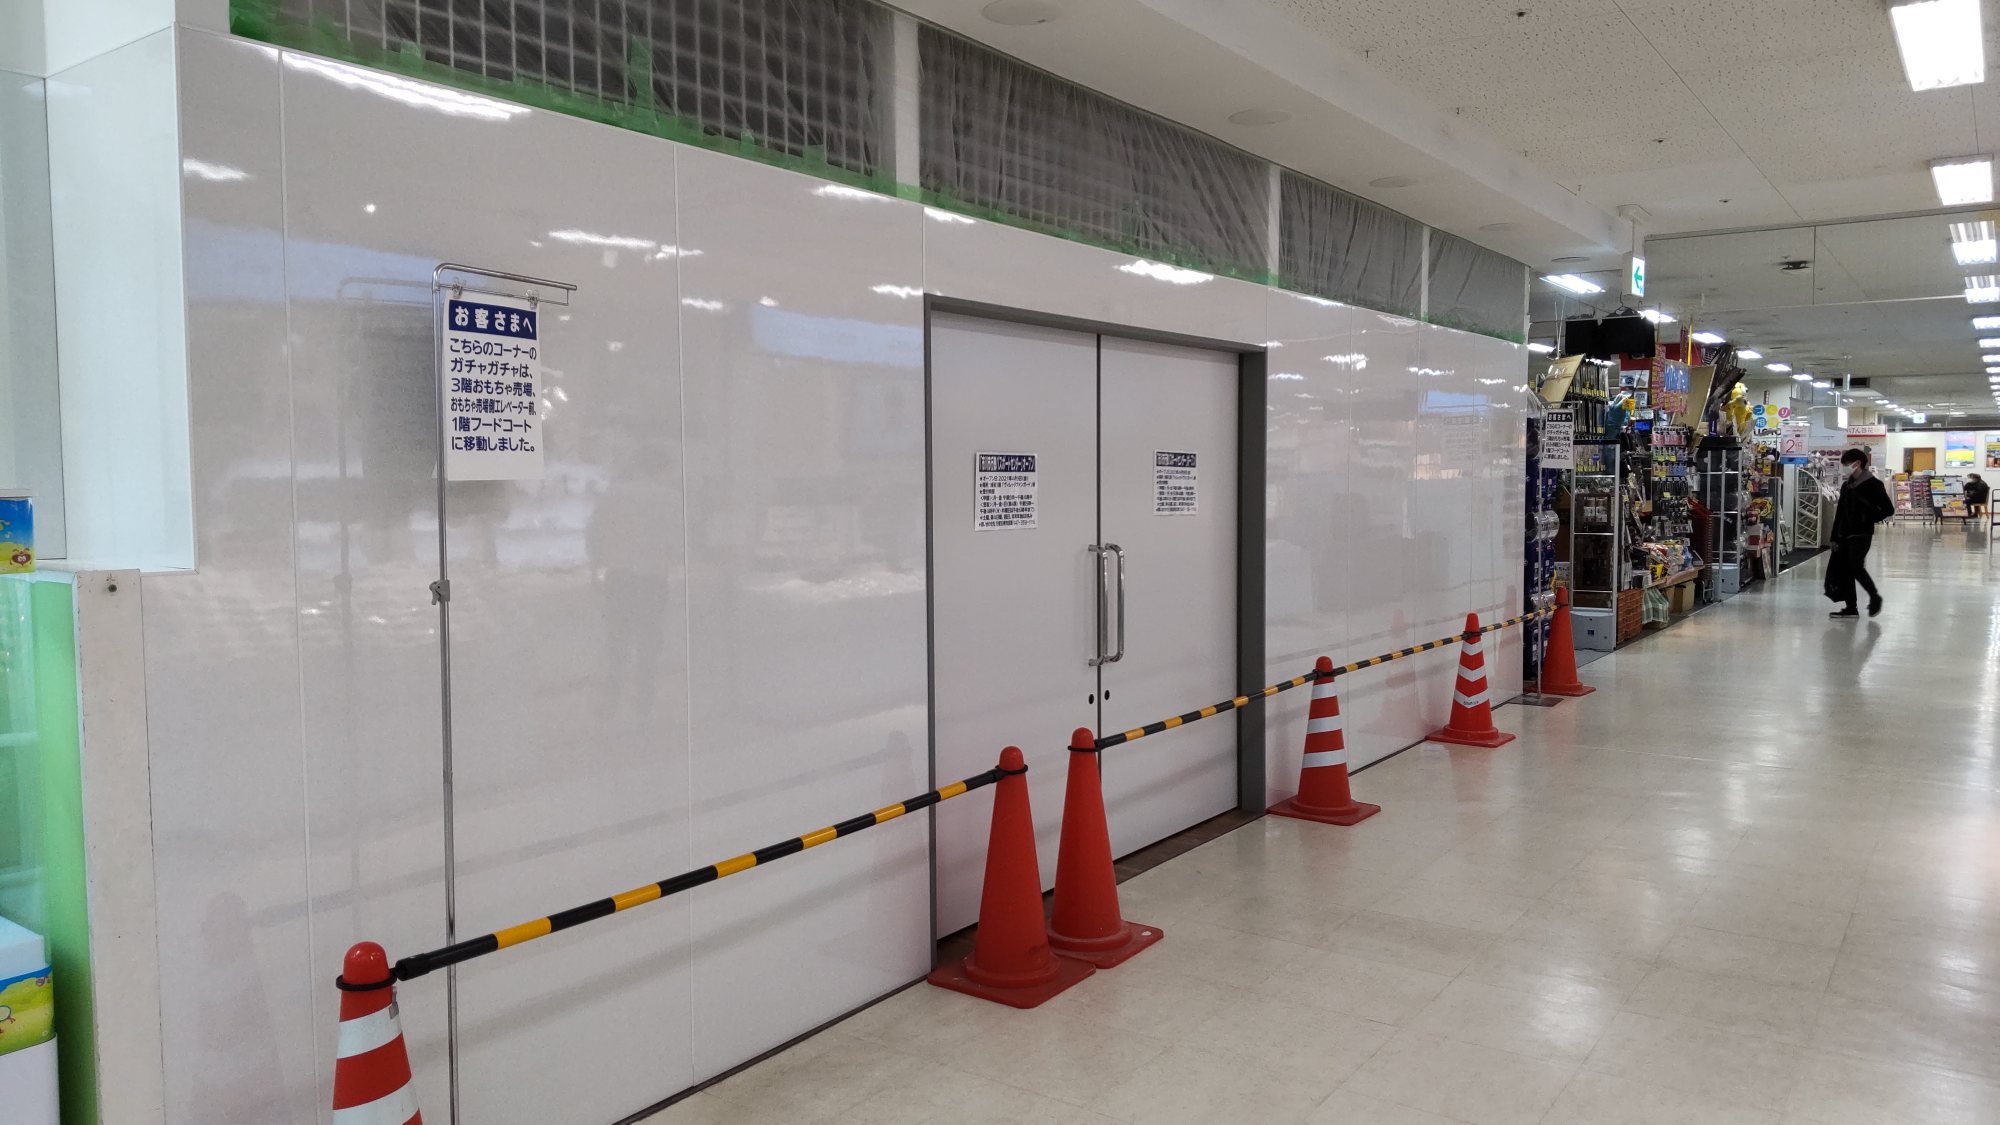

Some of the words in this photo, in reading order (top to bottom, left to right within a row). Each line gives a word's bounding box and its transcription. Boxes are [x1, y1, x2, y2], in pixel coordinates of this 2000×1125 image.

[454, 305, 533, 334] お客さまへ
[450, 337, 537, 361] こちらのコーナーの
[450, 357, 534, 379] ガチャガチャは、
[451, 377, 536, 398] 3階おもちゃ売場、
[451, 416, 532, 434] 1階フードコート
[451, 435, 535, 452] に移動しました。
